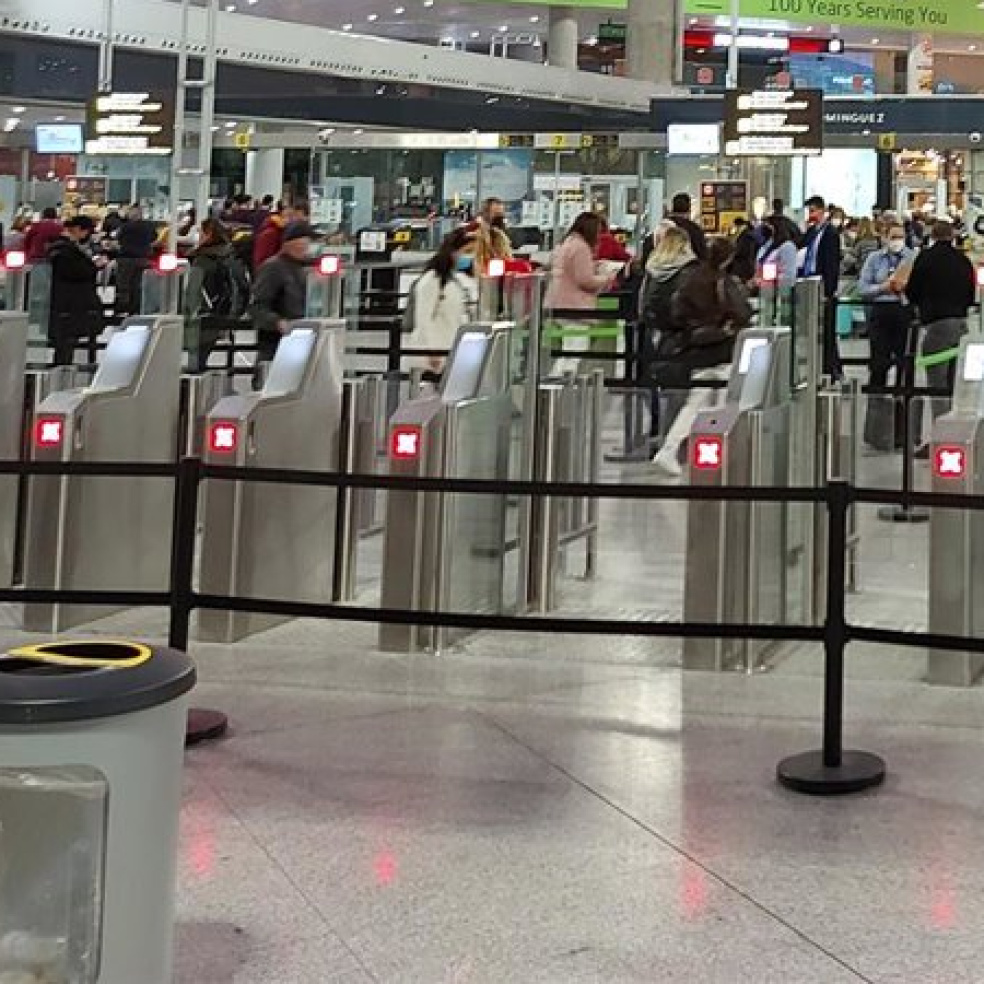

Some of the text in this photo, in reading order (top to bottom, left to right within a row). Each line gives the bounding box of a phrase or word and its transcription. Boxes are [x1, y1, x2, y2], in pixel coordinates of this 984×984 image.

[856, 2, 915, 25] Serving
[918, 6, 948, 25] You
[824, 113, 884, 123] MINGUEZ
